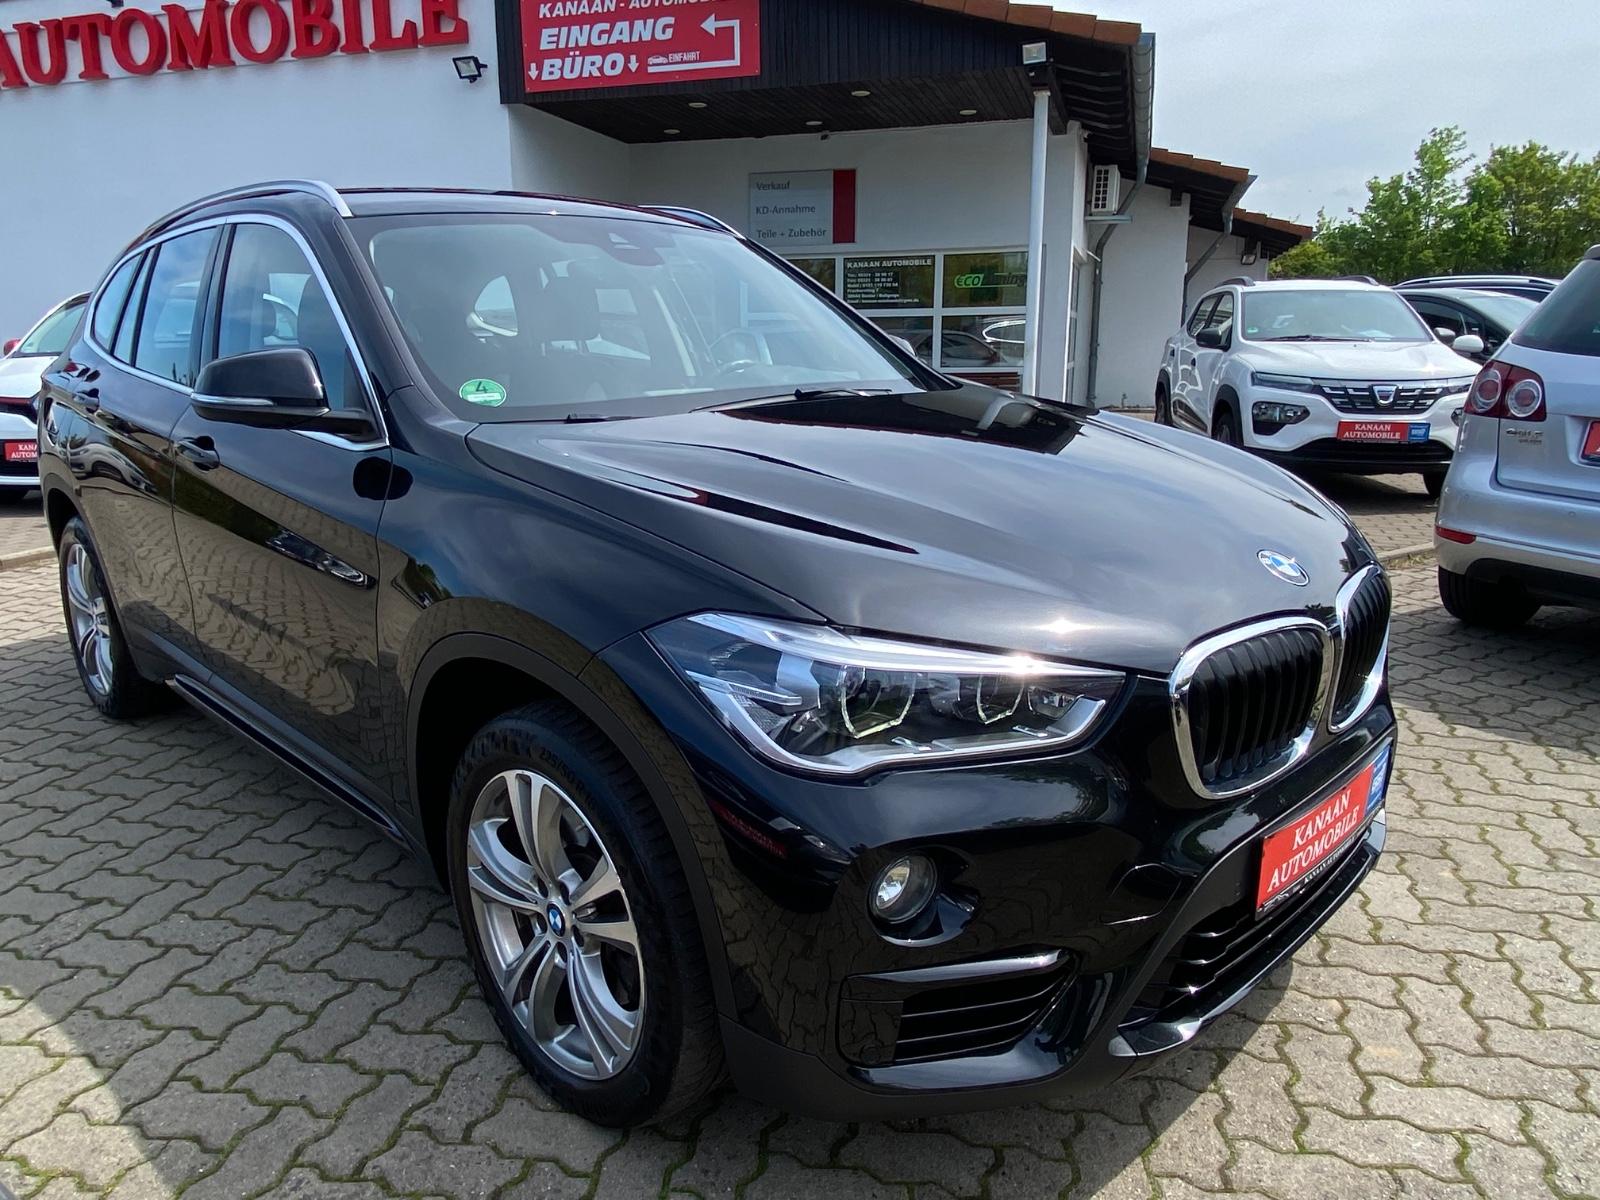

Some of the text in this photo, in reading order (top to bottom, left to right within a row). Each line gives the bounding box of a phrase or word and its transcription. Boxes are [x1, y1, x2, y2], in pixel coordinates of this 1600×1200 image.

[539, 0, 616, 18] KANAAN
[539, 16, 675, 50] EINGANG
[669, 50, 700, 63] EINFAHRT
[541, 51, 625, 81] BÜRO
[756, 180, 791, 190] Verkauf
[755, 204, 816, 215] KD-Annahme
[757, 229, 777, 239] Teile
[788, 227, 827, 238] Zubehör
[882, 258, 932, 267] AUTOMOBILE
[476, 381, 489, 393] 4
[1354, 423, 1392, 431] KANAAN
[1343, 431, 1401, 439] AUTOMOBILE
[1292, 789, 1352, 851] KANAAN
[1267, 806, 1359, 893] AUTOMOBILE
